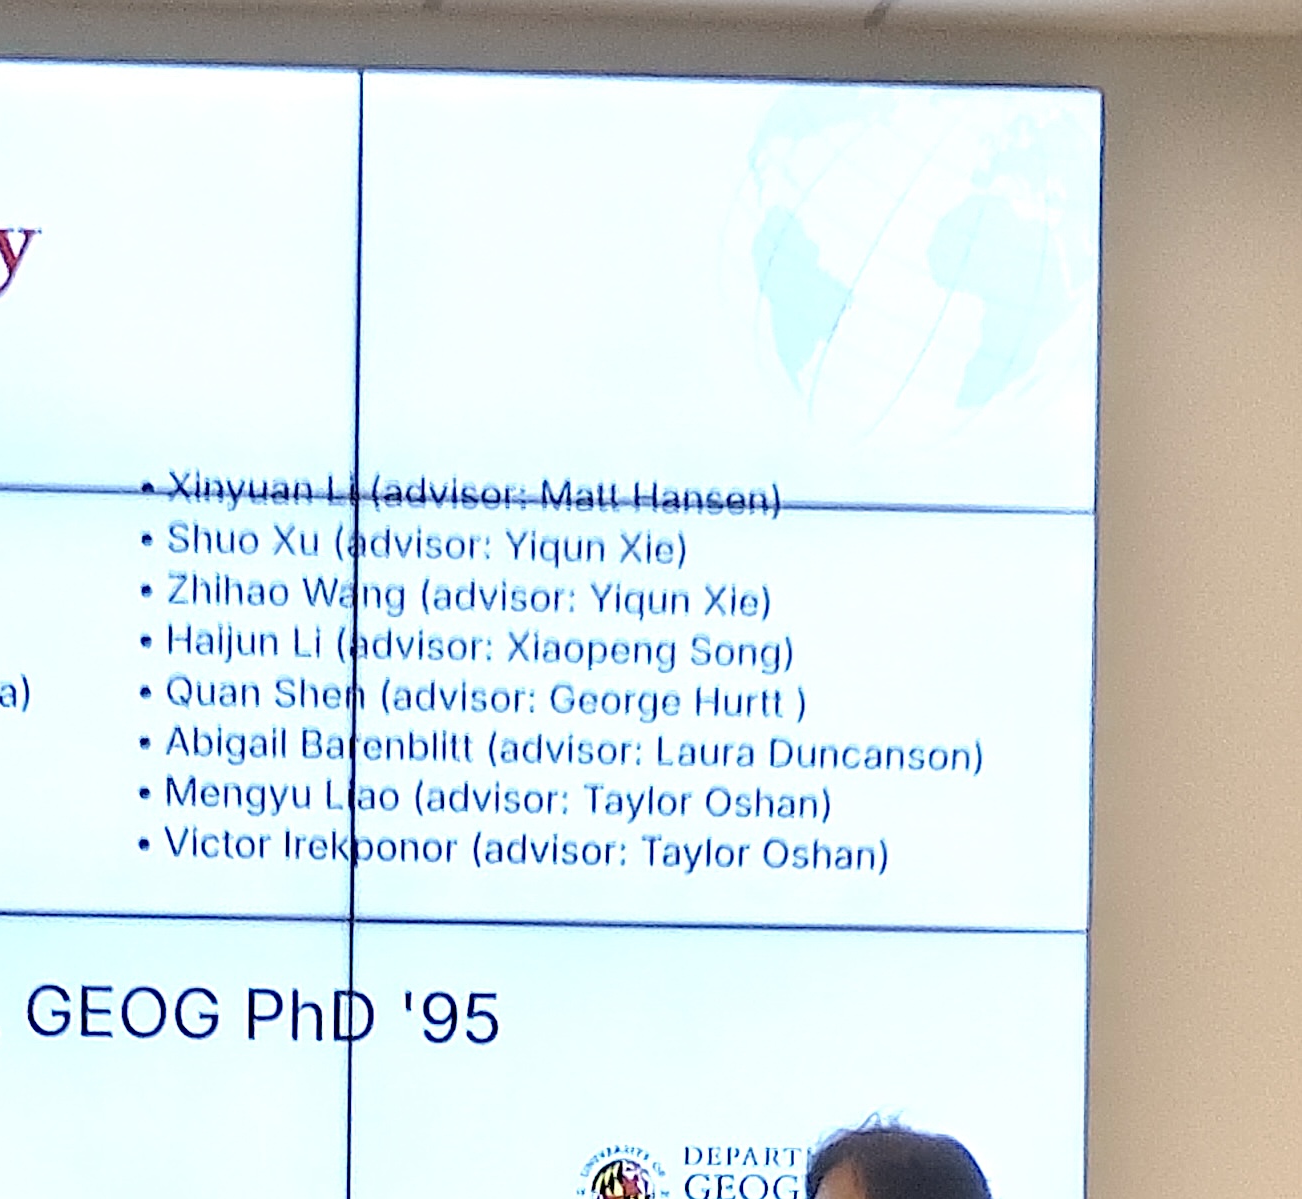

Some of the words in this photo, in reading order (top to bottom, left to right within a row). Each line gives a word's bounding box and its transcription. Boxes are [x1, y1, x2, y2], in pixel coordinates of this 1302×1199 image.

[168, 471, 313, 511] Xinyuan
[372, 474, 526, 513] (advisor:
[542, 480, 618, 512] Matt
[634, 482, 781, 518] Hansen)
[168, 521, 259, 555] Shuo
[273, 524, 318, 557] Xu
[336, 524, 491, 561] (advisor:
[506, 528, 605, 568] Yiqun
[620, 530, 686, 568] Xie)
[168, 573, 289, 606] Zhihao
[304, 577, 405, 617] Wang
[422, 577, 575, 616] (advisor:
[591, 582, 689, 620] Yiqun
[704, 583, 770, 620] Xie)
[168, 624, 278, 662] Haijun
[295, 626, 320, 658] Li
[337, 626, 491, 662] (advisor:
[509, 631, 676, 673] Xiaopeng
[691, 634, 793, 674] Song)
[167, 676, 260, 709] Quan
[275, 678, 365, 709] Shen
[382, 678, 535, 715] (advisor:
[551, 683, 680, 722] George
[696, 686, 783, 718] Hurtt
[797, 686, 806, 722] )
[166, 726, 287, 764] Abigail
[302, 729, 473, 763] Barenblitt
[489, 731, 641, 767] (advisor:
[657, 735, 755, 767] Laura
[770, 738, 983, 776] Duncanson)
[165, 775, 311, 816] Mengyu
[326, 779, 399, 811] Liao
[415, 779, 567, 818] (advisor:
[584, 783, 692, 823] Taylor
[705, 786, 830, 823] Oshan)
[165, 826, 271, 859] Victor
[285, 828, 458, 867] Irekponor
[473, 831, 626, 869] (advisor:
[642, 835, 750, 874] Taylor
[763, 837, 888, 875] Oshan)
[27, 984, 219, 1040] GEOG
[246, 988, 374, 1044] PhD
[404, 991, 499, 1045] '95
